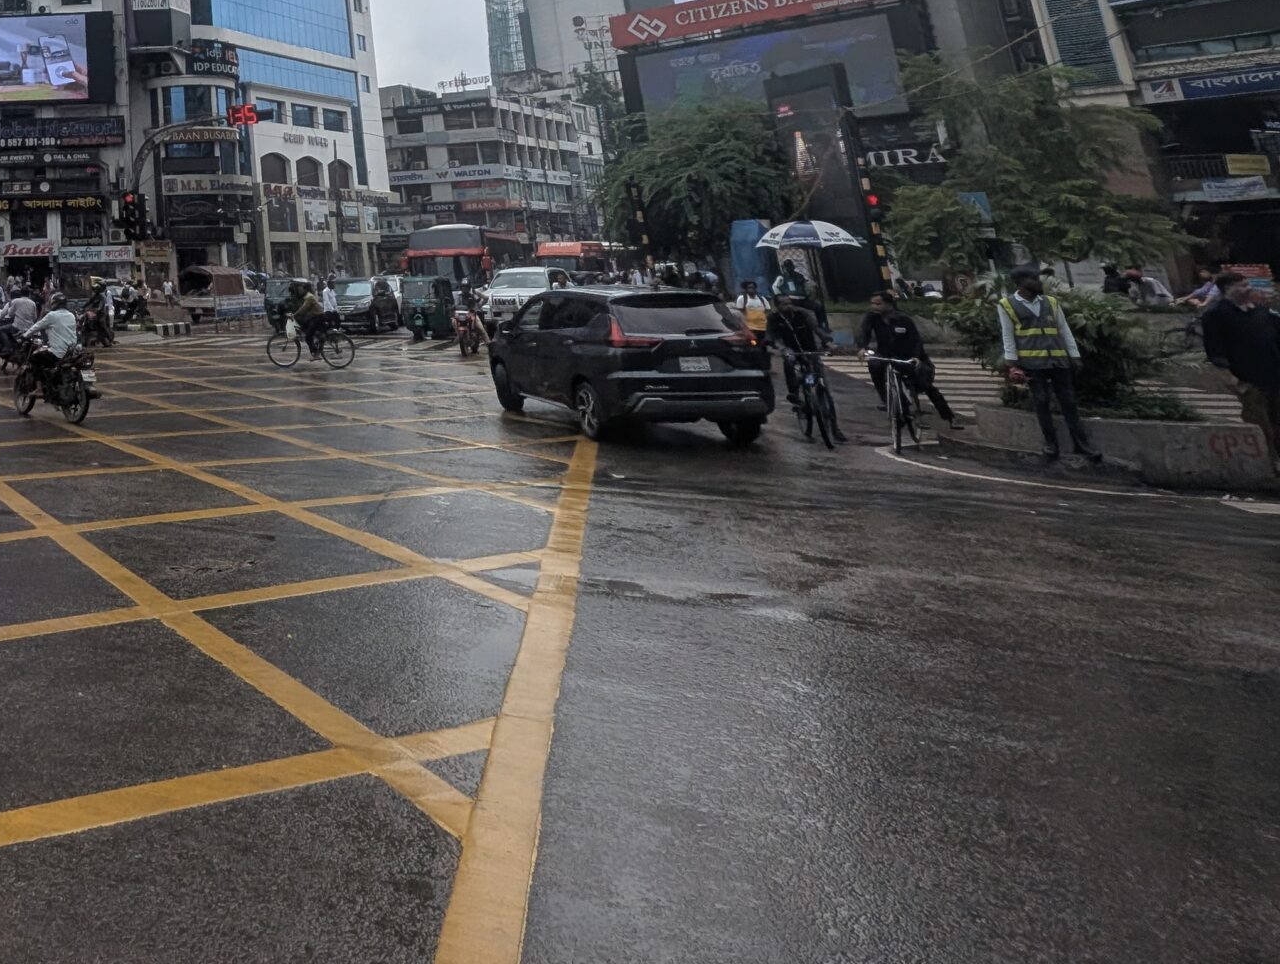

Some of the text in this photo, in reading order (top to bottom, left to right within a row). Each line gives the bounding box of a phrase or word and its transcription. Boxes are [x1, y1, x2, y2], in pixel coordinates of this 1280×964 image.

[225, 48, 238, 63] IEL
[193, 62, 238, 75] IDP EDUCAT
[172, 131, 200, 141] BAAN
[453, 168, 491, 178] WALTON
[427, 203, 456, 213] SONY
[2, 242, 55, 256] Bata
